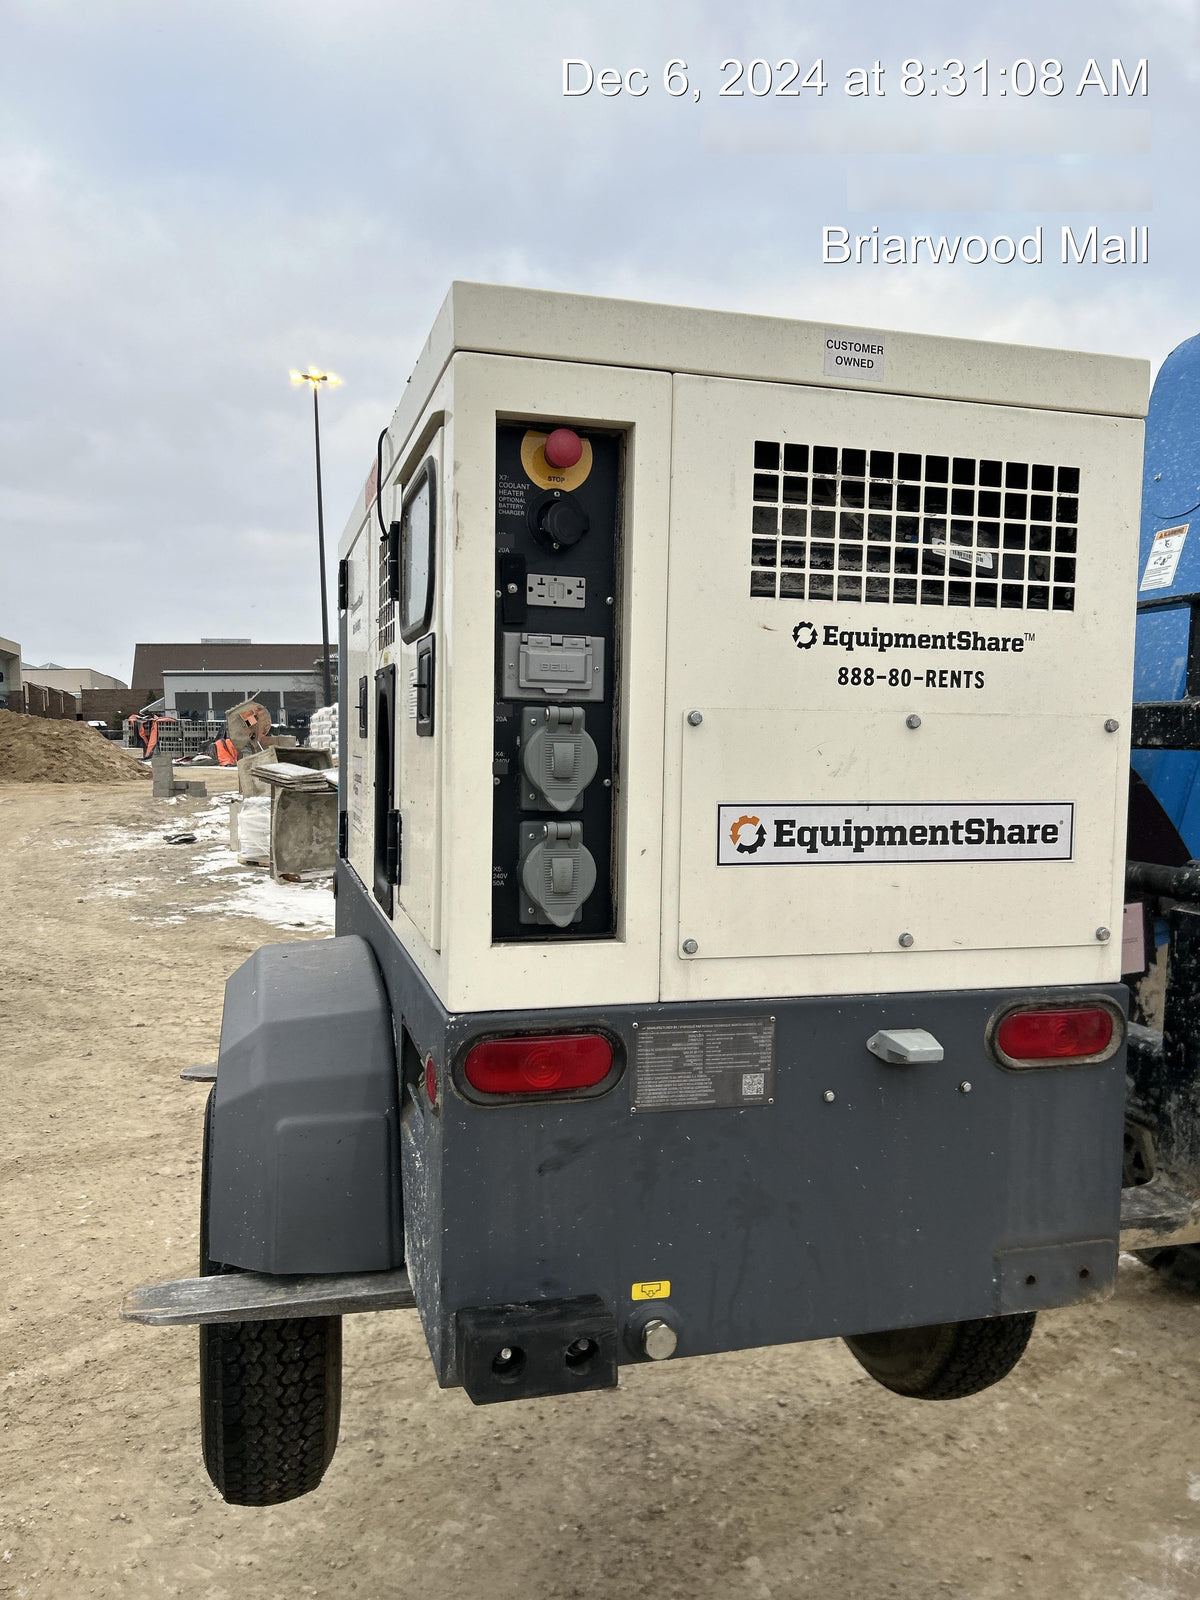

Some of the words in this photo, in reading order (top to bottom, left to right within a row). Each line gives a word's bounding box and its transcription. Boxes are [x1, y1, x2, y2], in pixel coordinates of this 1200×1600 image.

[826, 339, 884, 355] CUSTOMER
[835, 355, 874, 369] OWNED
[547, 475, 566, 483] STOP
[498, 481, 530, 490] COOLANT
[498, 489, 525, 497] HEATER
[498, 496, 526, 504] OPTIONAL
[540, 663, 575, 673] BELL
[837, 666, 985, 689] 888-80-RENTS
